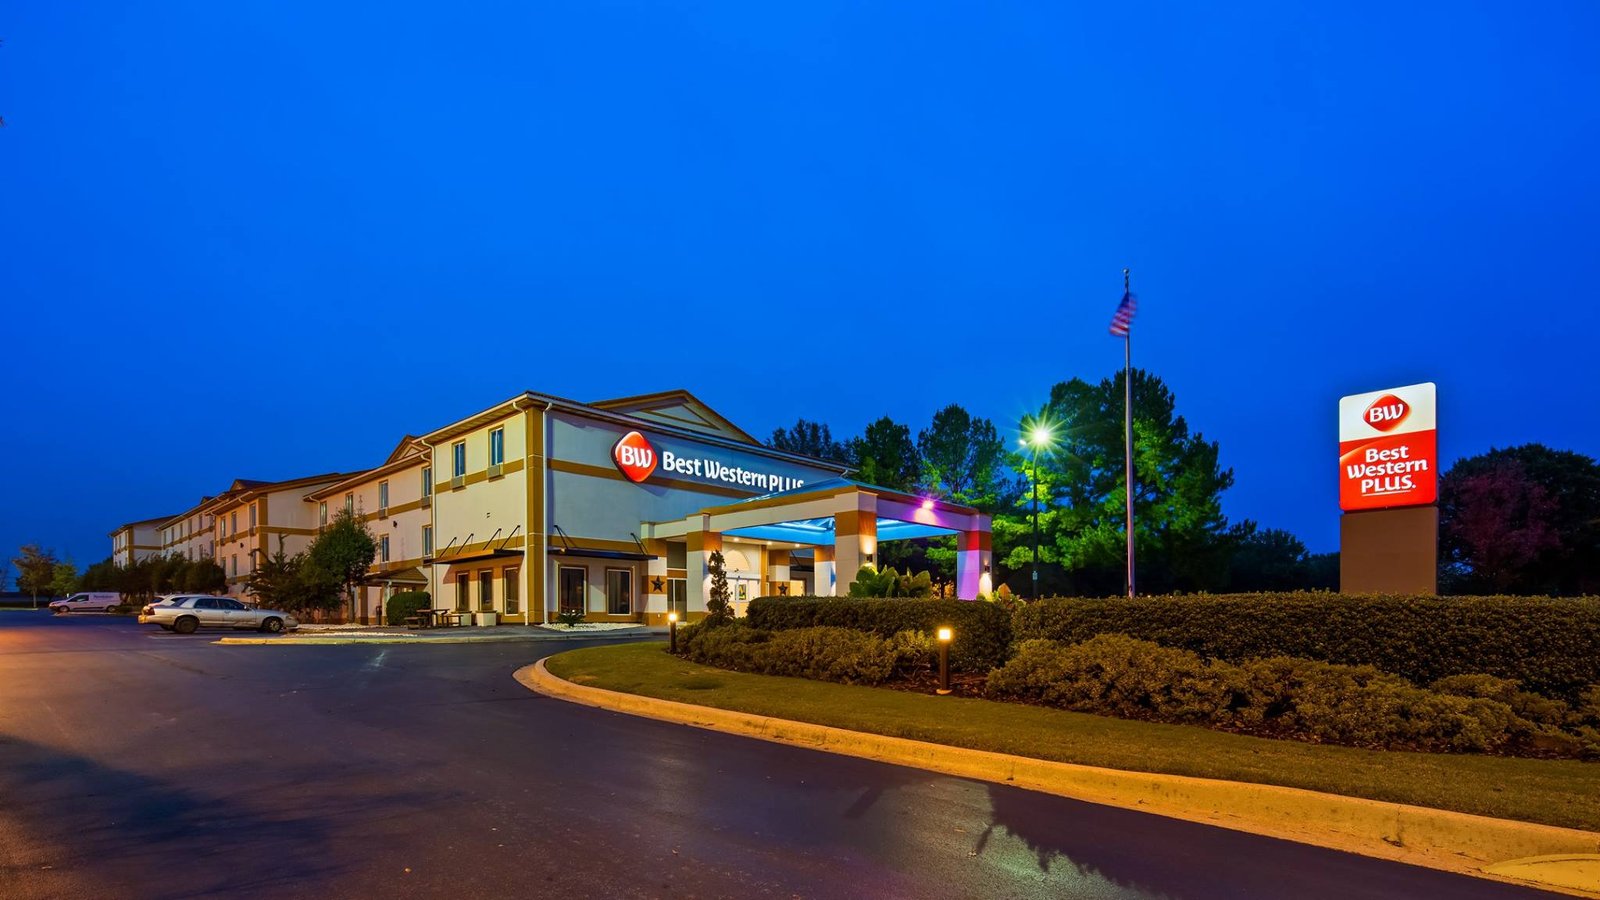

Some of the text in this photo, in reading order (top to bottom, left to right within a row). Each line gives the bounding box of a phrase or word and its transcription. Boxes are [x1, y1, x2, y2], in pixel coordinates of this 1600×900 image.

[1369, 403, 1404, 423] BW
[621, 445, 652, 468] BW
[1365, 445, 1409, 463] Best
[662, 451, 701, 477] Best
[704, 459, 767, 488] Western
[1346, 459, 1428, 479] Western
